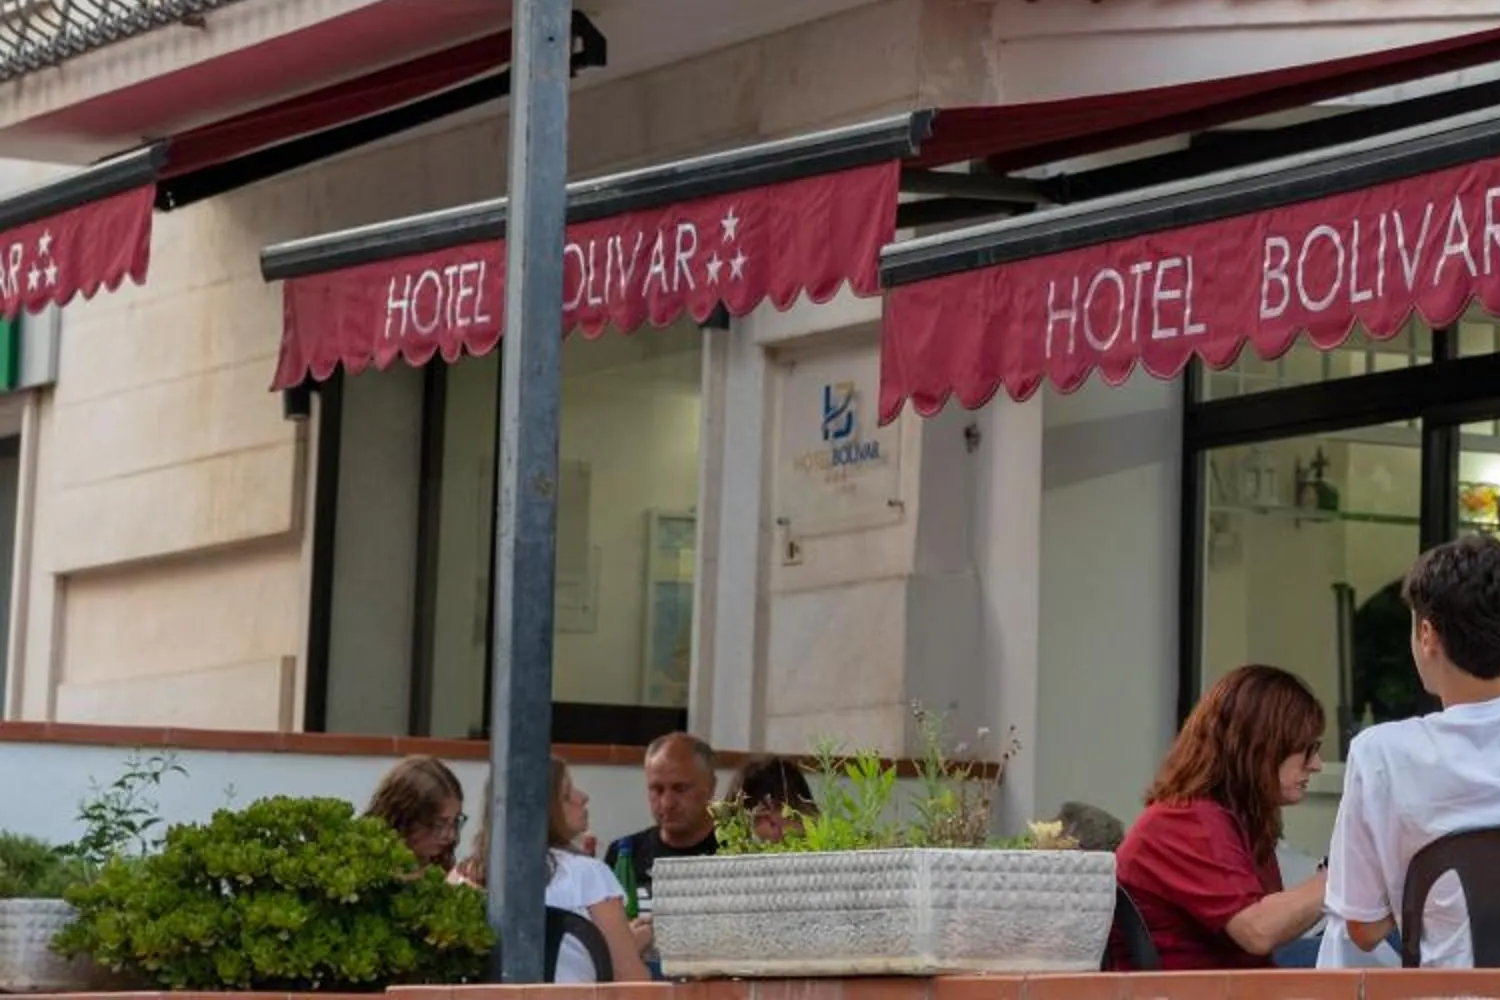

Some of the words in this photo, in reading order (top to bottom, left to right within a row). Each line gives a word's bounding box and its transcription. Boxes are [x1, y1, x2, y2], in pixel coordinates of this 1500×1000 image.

[384, 259, 490, 339] HOTEL
[562, 222, 697, 311] OLIVAR
[1045, 254, 1207, 359] HOTEL
